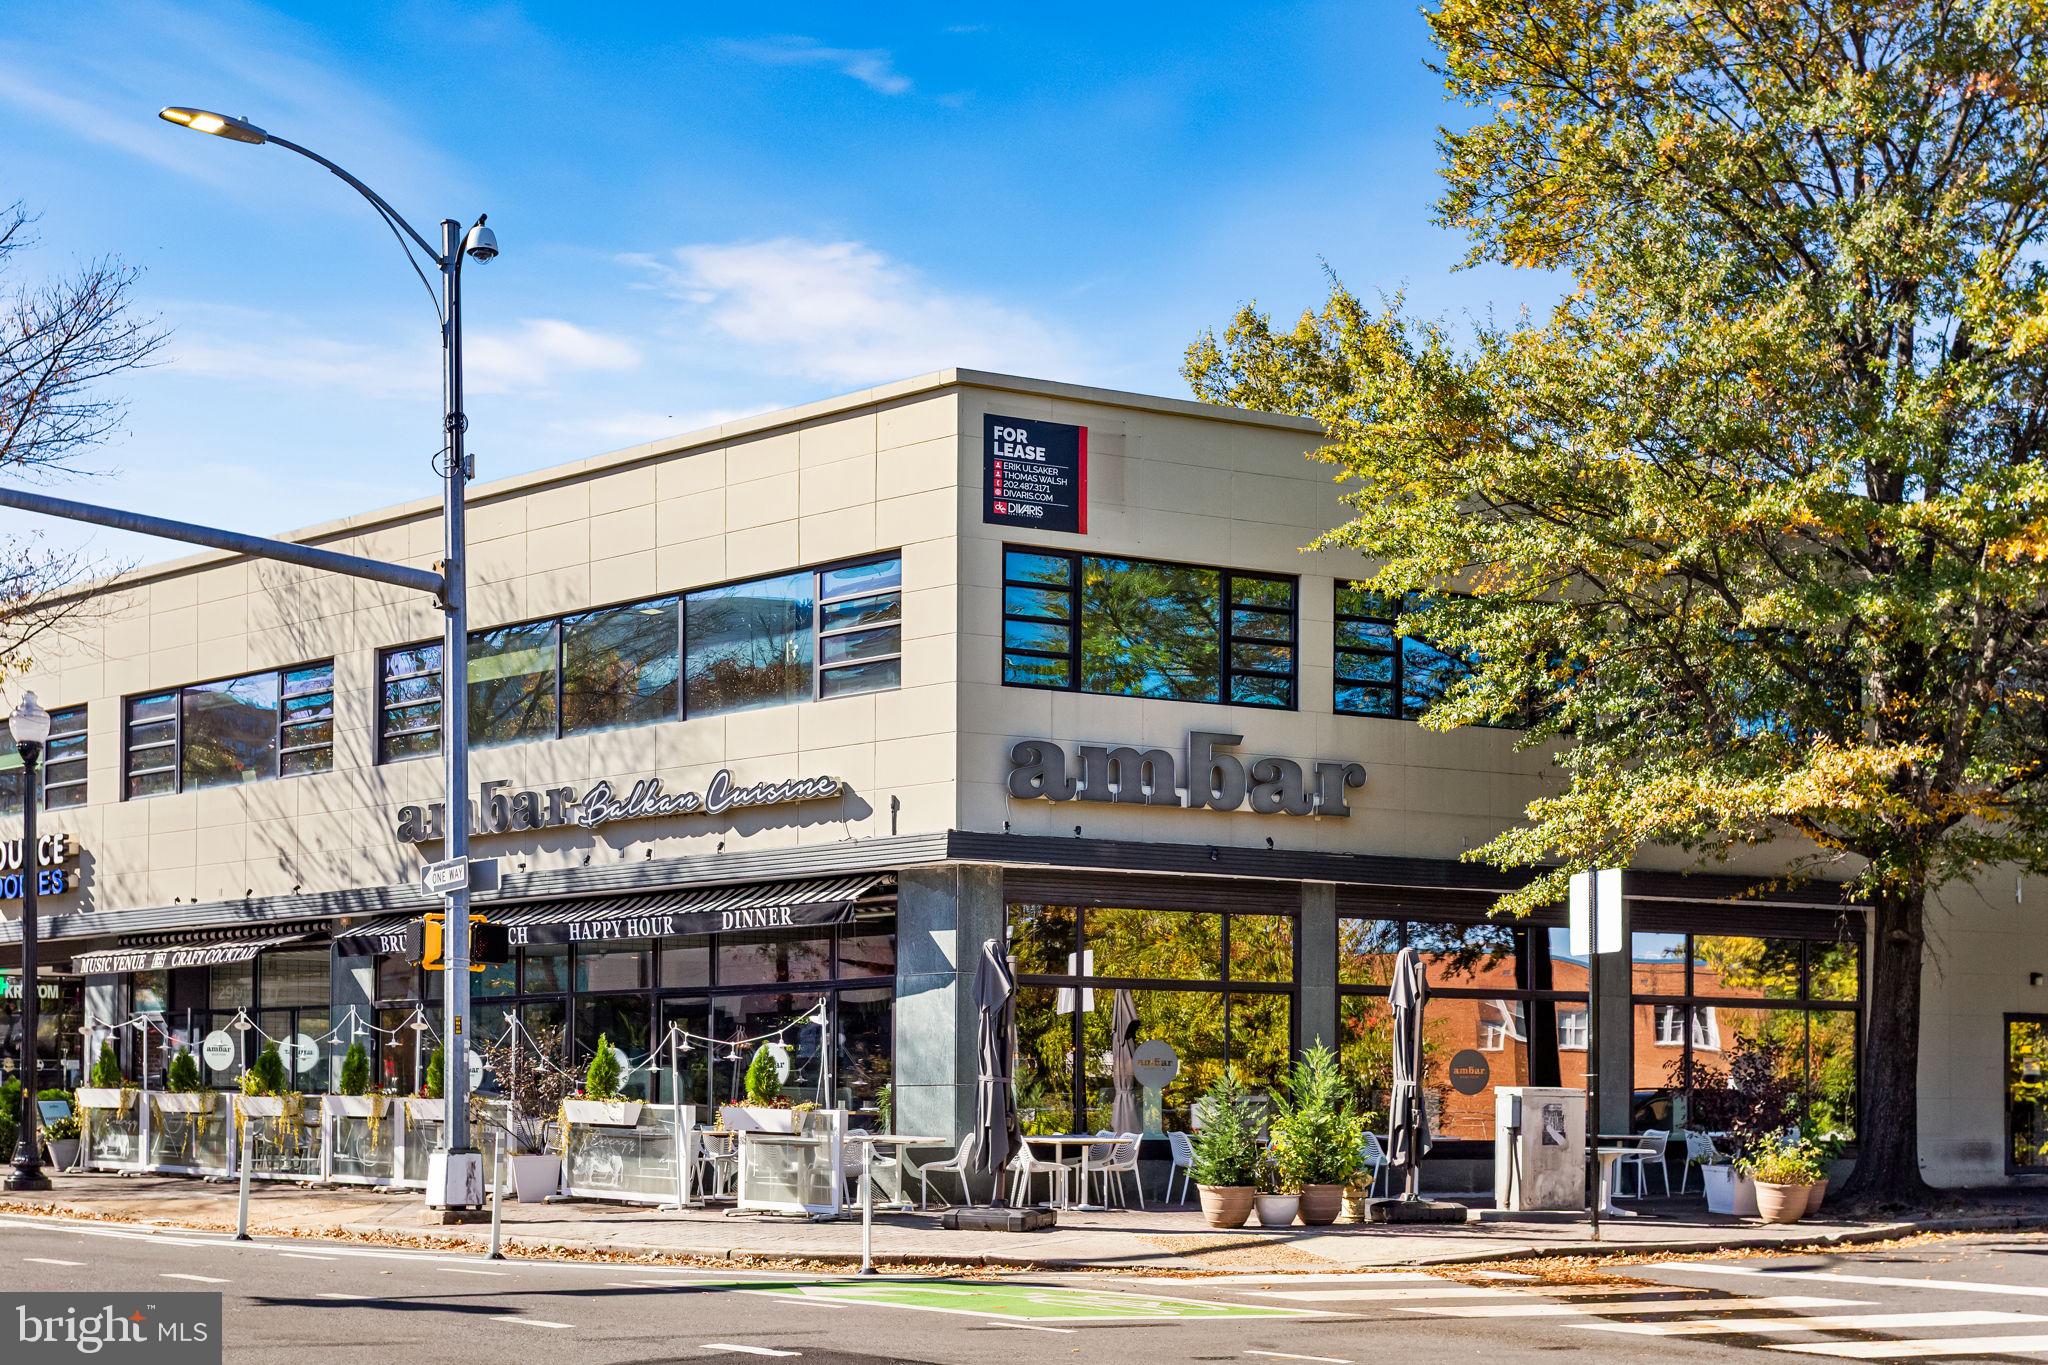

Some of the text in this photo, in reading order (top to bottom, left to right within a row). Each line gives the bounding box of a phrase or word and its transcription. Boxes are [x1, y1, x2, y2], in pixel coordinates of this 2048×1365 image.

[993, 425, 1028, 443] FOR
[993, 441, 1046, 461] LEASE
[1003, 462, 1059, 476] ERIK ULSAKER
[1003, 471, 1068, 486] THOMAS WALSH
[1003, 480, 1051, 493] 202.487.3171
[1003, 489, 1054, 502] DIVARIS.COM
[1007, 502, 1044, 517] DIVARIS
[1007, 730, 1368, 818] ambar
[577, 779, 702, 829] Balkan
[704, 768, 843, 815] Cuisine
[432, 865, 464, 884] ONE WAY
[721, 905, 794, 931] DINNER
[568, 915, 676, 942] HAPPY HOUR
[80, 956, 112, 974] MUSIC
[112, 954, 147, 973] VENUE
[171, 949, 208, 967] CRAFT
